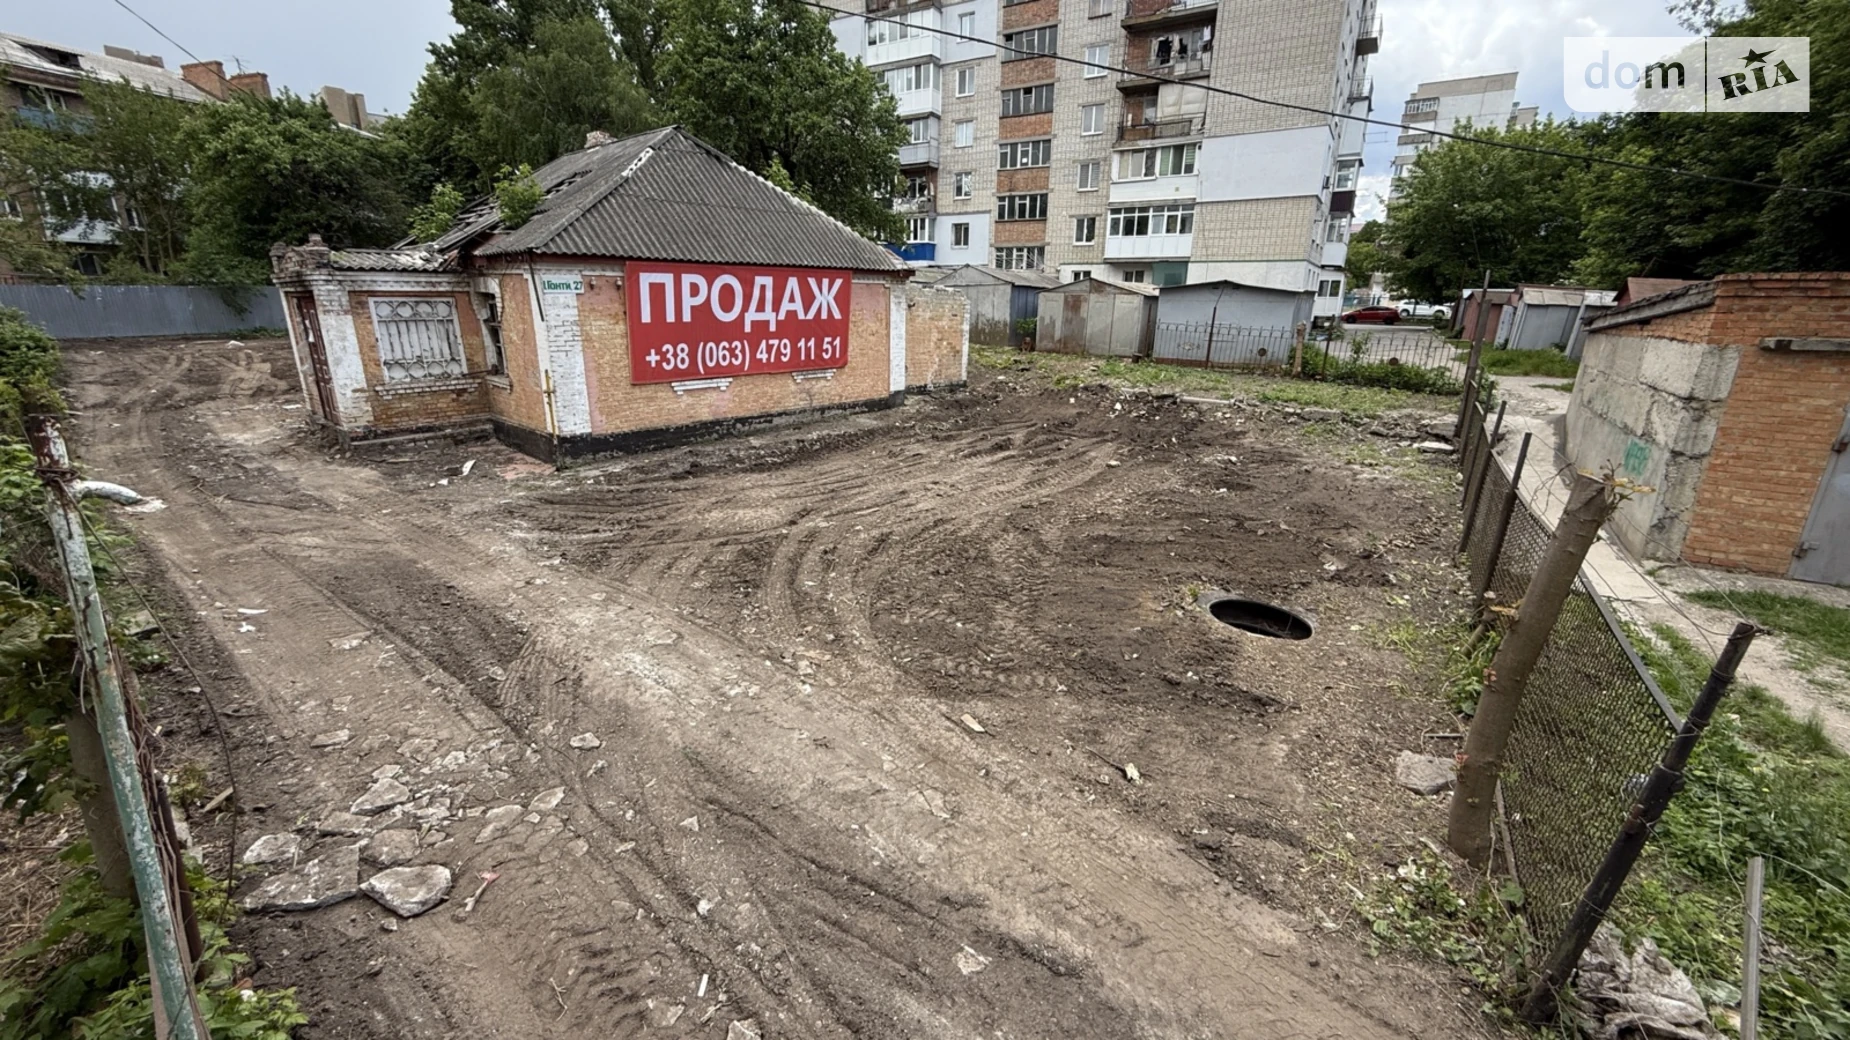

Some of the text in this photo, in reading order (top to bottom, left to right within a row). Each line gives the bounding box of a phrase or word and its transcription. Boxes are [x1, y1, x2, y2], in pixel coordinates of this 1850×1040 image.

[573, 280, 583, 290] 27
[639, 272, 843, 333] ПРОДАЖ
[645, 336, 841, 374] +38 (063) 479 11 51
